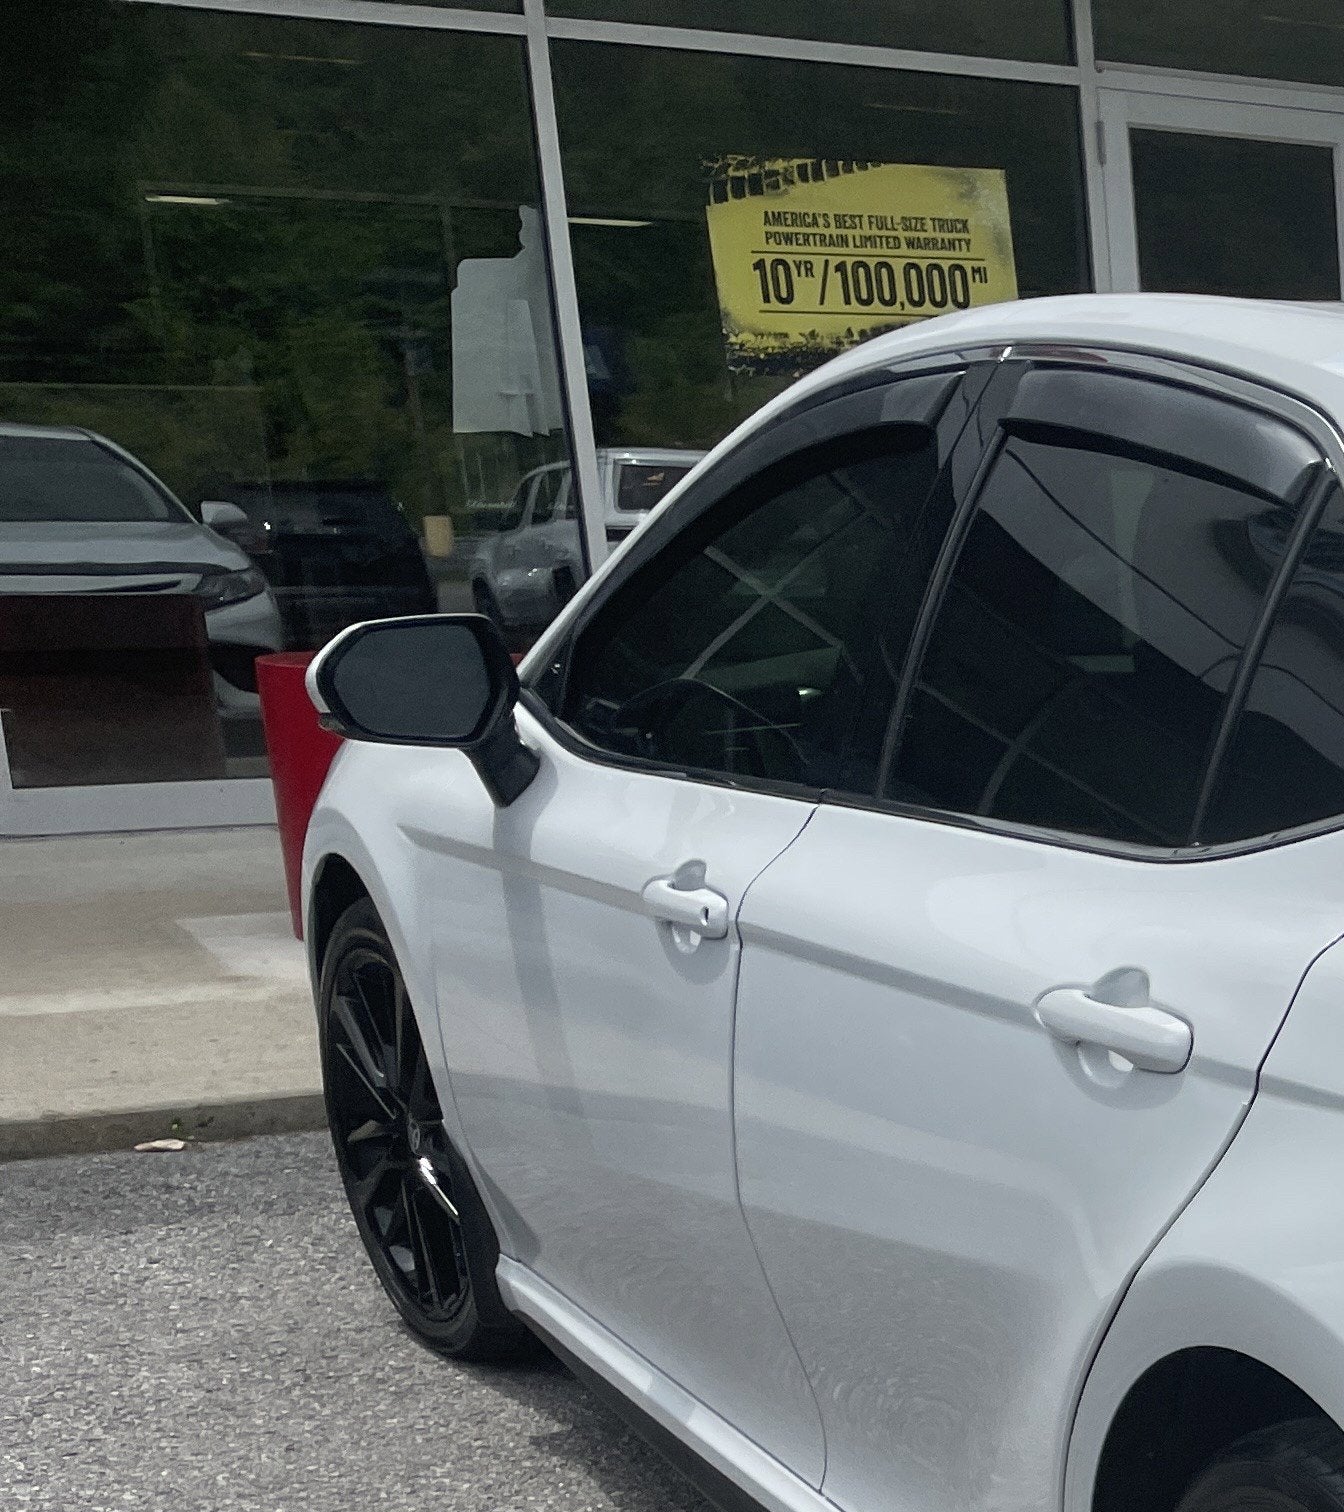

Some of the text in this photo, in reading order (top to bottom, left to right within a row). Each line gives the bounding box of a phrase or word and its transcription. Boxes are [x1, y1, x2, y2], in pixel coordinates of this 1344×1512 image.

[763, 210, 970, 234] AMERICA'S BEST FULL-SIZE TRUCK
[765, 231, 971, 253] POWERTRAIN LIMITED WARRANTY
